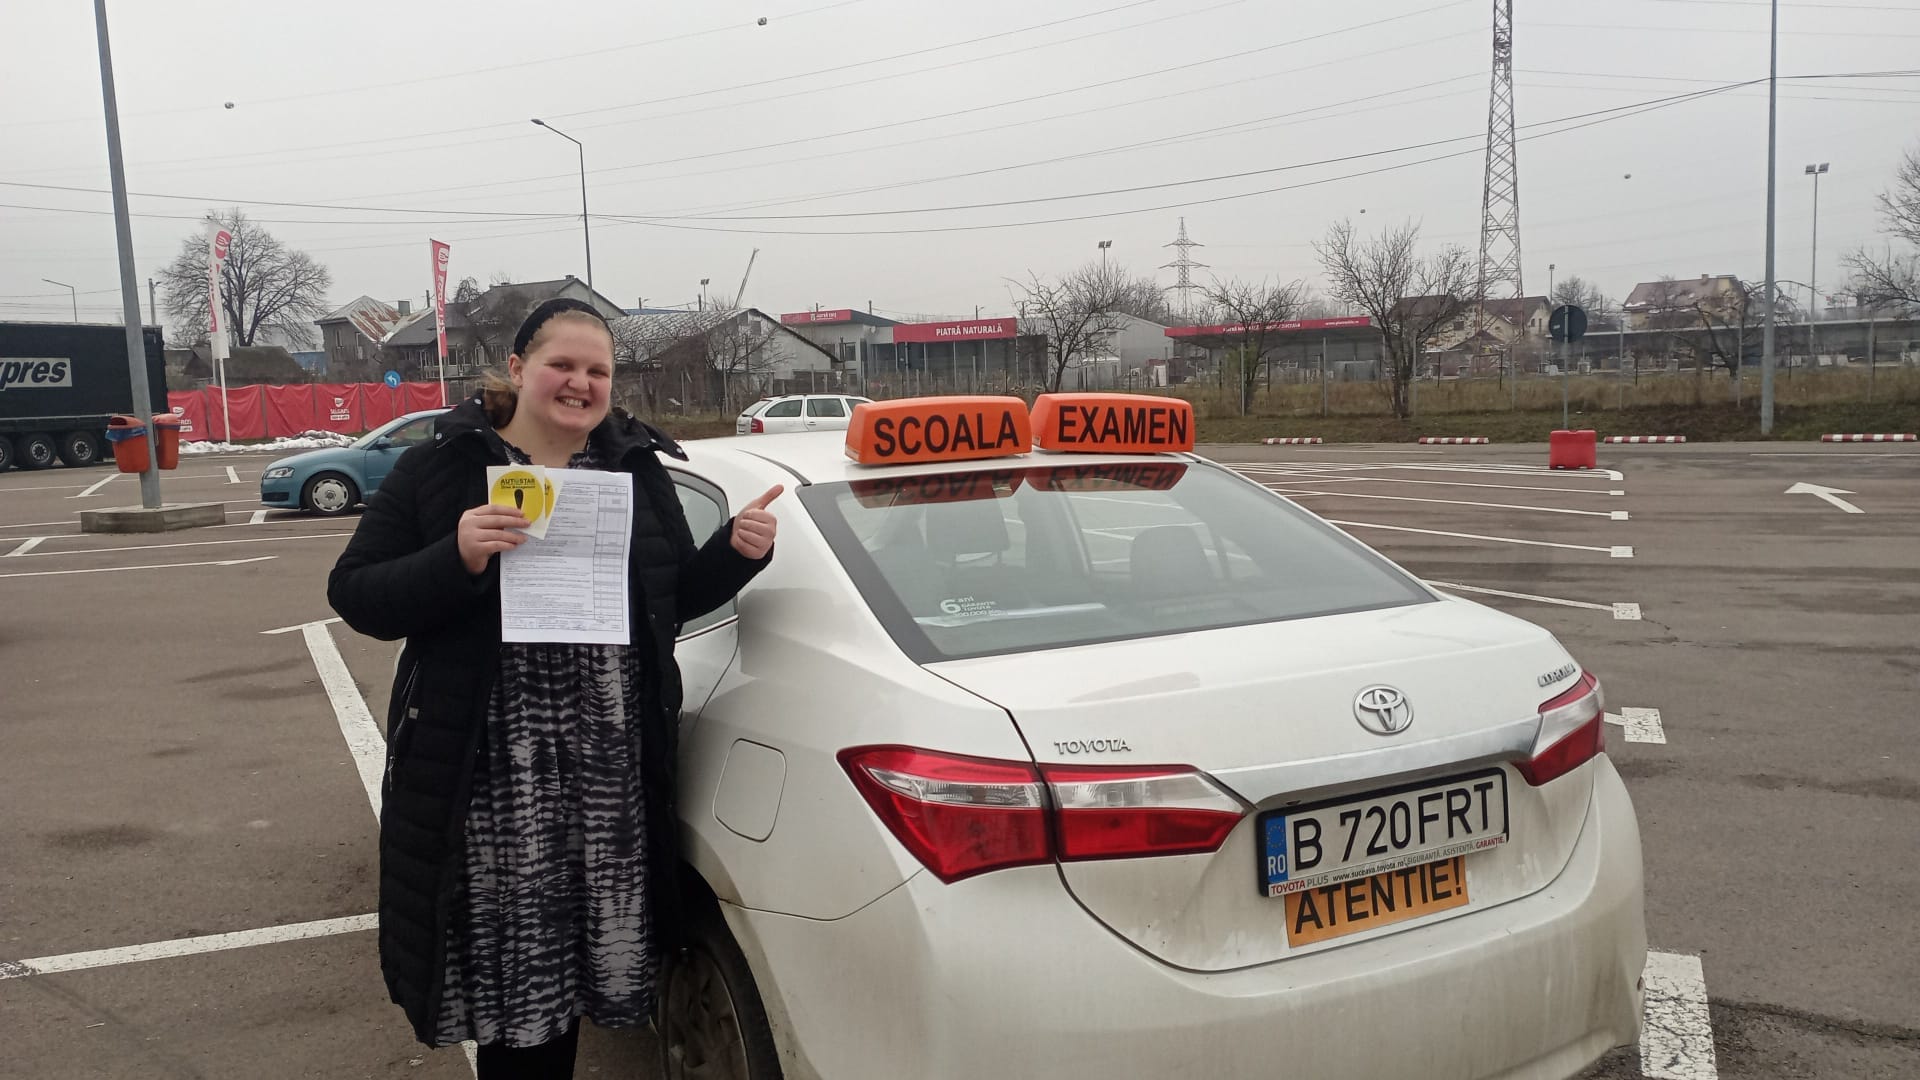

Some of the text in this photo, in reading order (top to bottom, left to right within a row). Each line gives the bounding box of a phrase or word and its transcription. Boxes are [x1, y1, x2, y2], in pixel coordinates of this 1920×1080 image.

[0, 361, 67, 390] pres
[873, 411, 1020, 457] SCOALA
[1058, 405, 1187, 445] EXAMEN
[940, 599, 962, 614] 6
[1054, 738, 1132, 755] TOYOTA
[1293, 817, 1323, 871] B
[1267, 854, 1287, 877] RO
[1271, 880, 1306, 895] TOYOTA
[1306, 875, 1329, 888] PLUS
[1295, 857, 1463, 935] ATENTIE!
